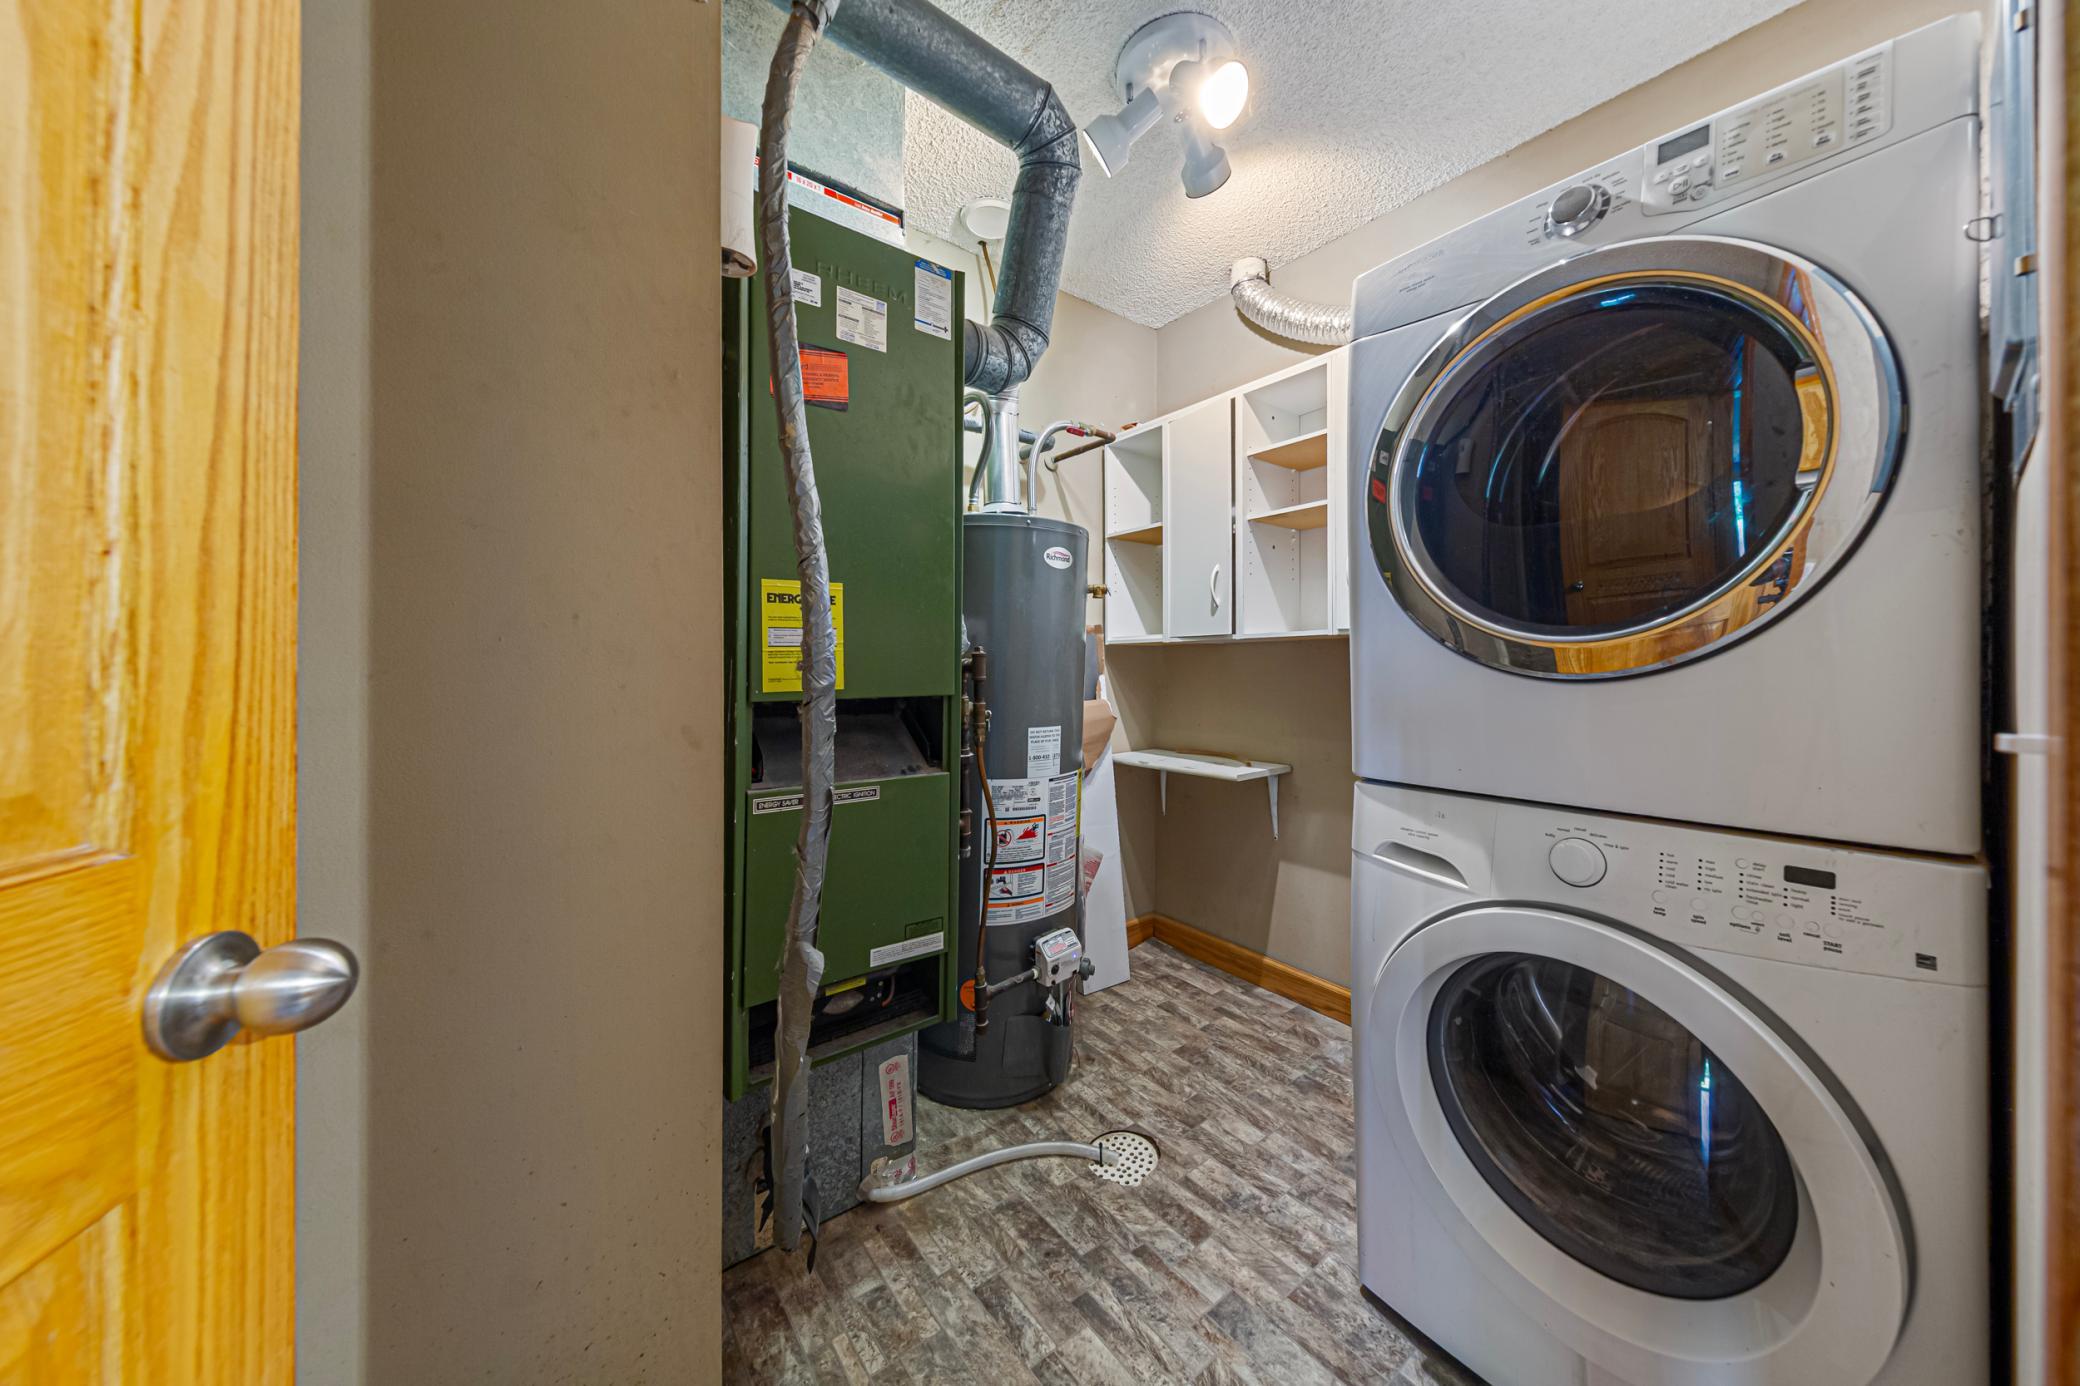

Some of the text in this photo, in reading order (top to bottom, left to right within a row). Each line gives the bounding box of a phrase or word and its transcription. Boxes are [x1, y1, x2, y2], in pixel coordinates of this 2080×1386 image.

[758, 800, 782, 810] ENERGY
[782, 798, 799, 807] SAVER
[853, 789, 876, 798] IGNITION
